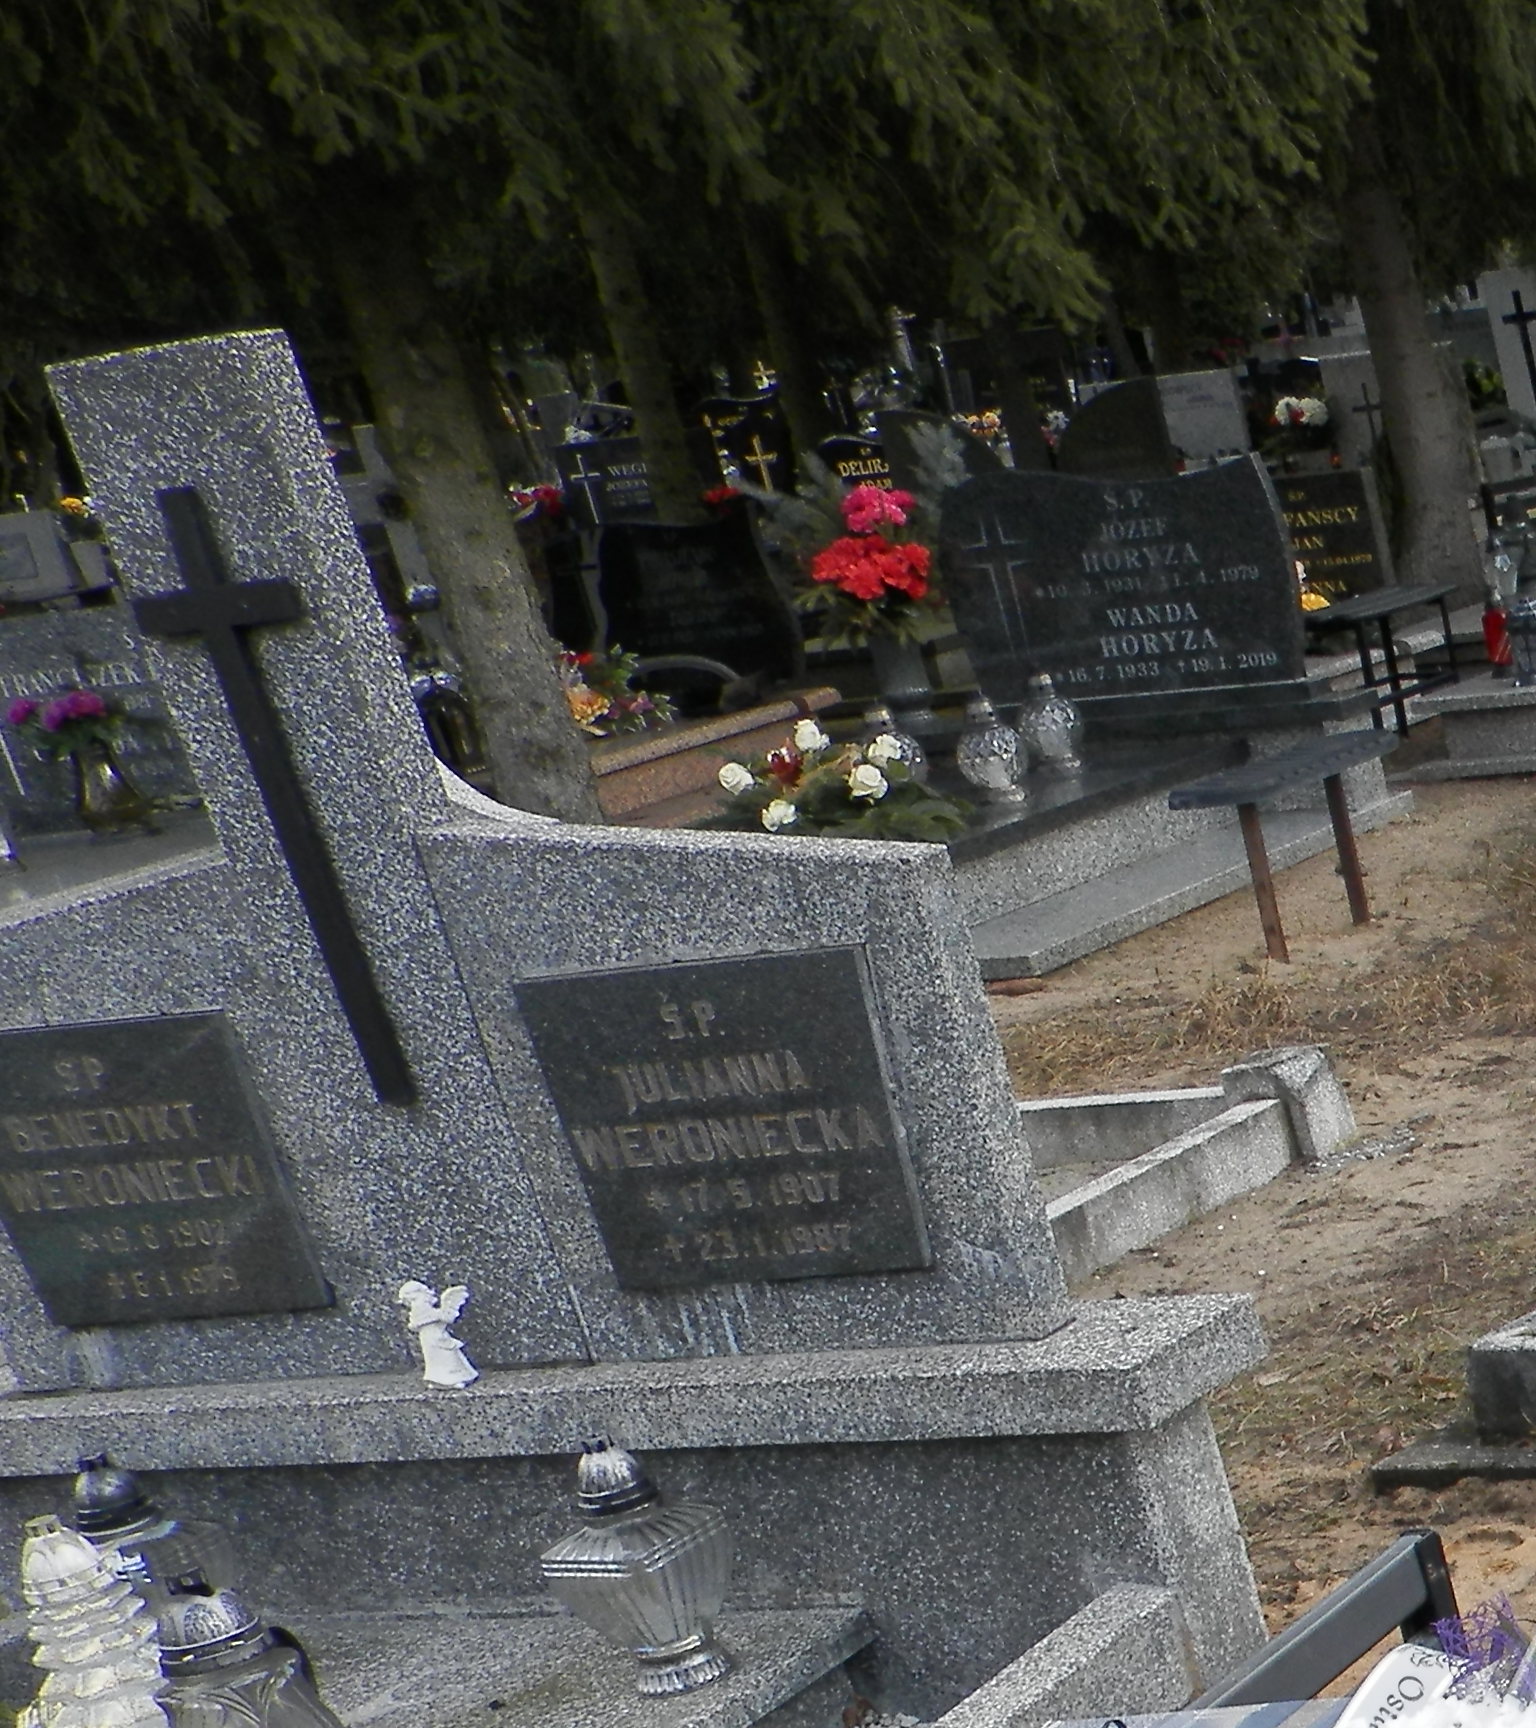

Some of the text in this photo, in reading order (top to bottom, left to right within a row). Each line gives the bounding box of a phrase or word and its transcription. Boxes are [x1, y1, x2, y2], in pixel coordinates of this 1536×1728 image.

[1082, 542, 1200, 573] HORYZA
[1106, 602, 1199, 628] WANDA
[1099, 628, 1218, 659] HORYZA
[1117, 660, 1161, 680] 1933
[1238, 650, 1278, 668] 2019
[604, 1050, 813, 1115] JULIANNA
[1, 1102, 200, 1153] BENEDYKT
[570, 1106, 887, 1172] WERONIECKA
[1, 1154, 267, 1213] WERONIECKI
[770, 1170, 842, 1206] 1907
